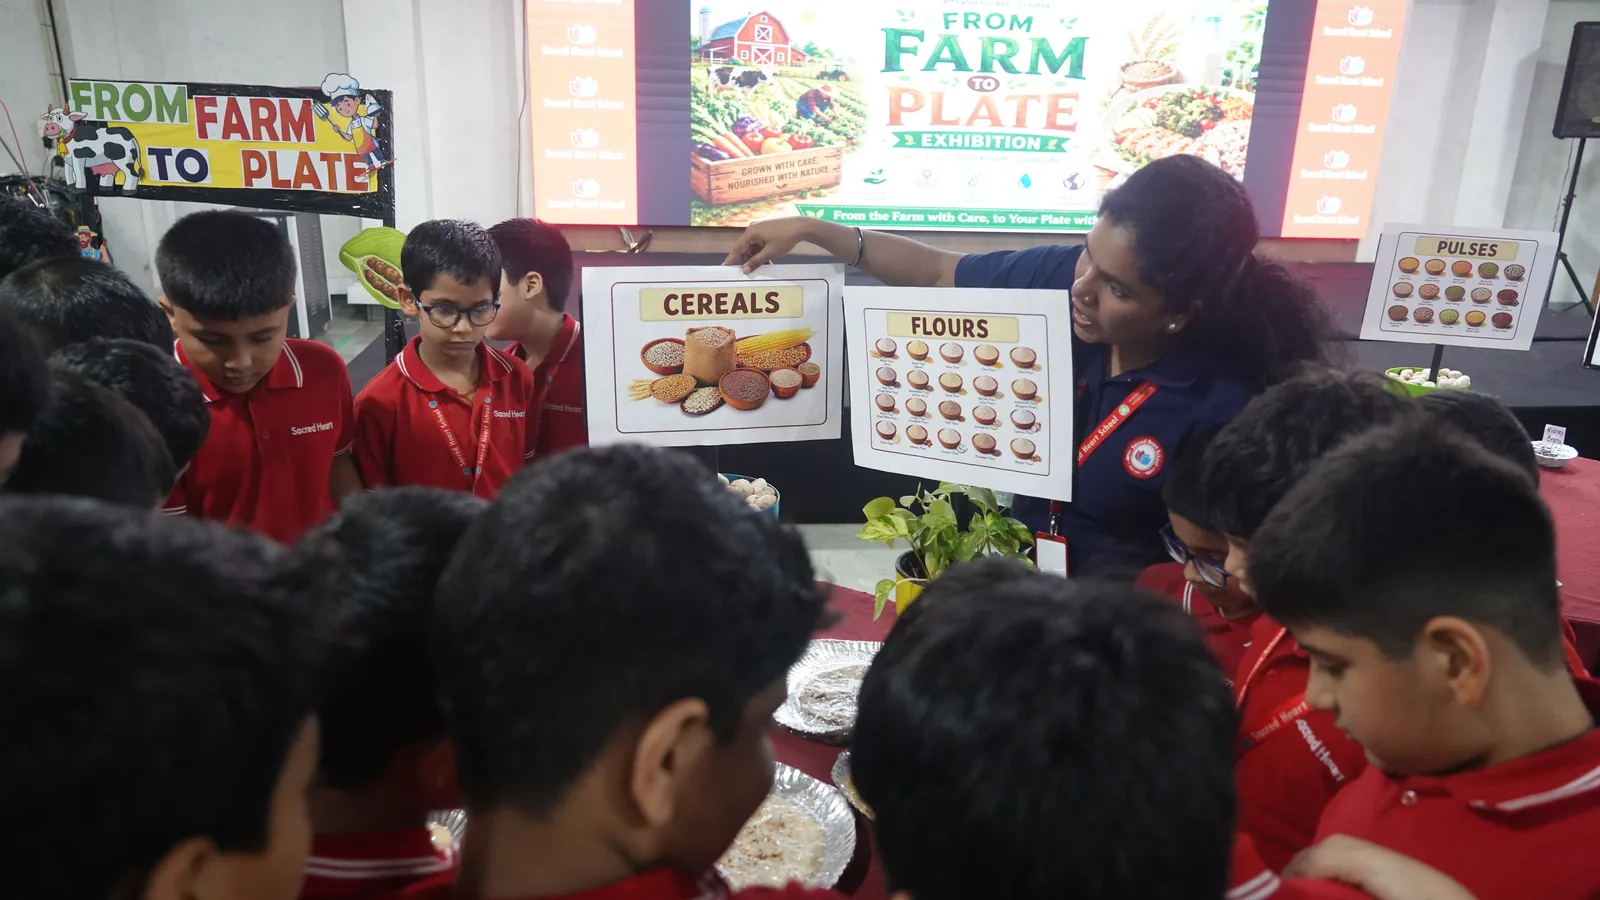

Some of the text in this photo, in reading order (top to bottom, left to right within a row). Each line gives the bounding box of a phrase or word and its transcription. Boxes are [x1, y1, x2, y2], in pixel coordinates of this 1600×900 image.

[943, 12, 1033, 33] FROM
[880, 27, 1090, 80] FARM
[973, 78, 997, 91] TO
[69, 81, 187, 123] FROM
[885, 85, 1080, 132] PLATE
[194, 96, 315, 143] FARM
[921, 133, 1041, 151] EXHIBITION
[147, 147, 371, 191] TO PLATE
[728, 165, 829, 191] NOURISHED WITH NATURE
[742, 163, 772, 177] GROWN
[775, 161, 795, 172] WITH
[833, 210, 1099, 225] From the Farm with Care, to Your Plate with
[1436, 240, 1499, 258] PULSES
[663, 291, 780, 316] CEREALS
[911, 316, 989, 339] FLOURS
[493, 409, 526, 418] Sacred Heart
[291, 421, 333, 436] Sacred Heart
[433, 408, 466, 467] Sacred Heart School
[481, 425, 489, 442] Heart
[1081, 415, 1119, 453] Heart School
[478, 444, 487, 464] Sacred
[1130, 438, 1147, 450] Sacred
[1251, 701, 1308, 740] Sacred Heart
[1315, 746, 1345, 782] Heart
